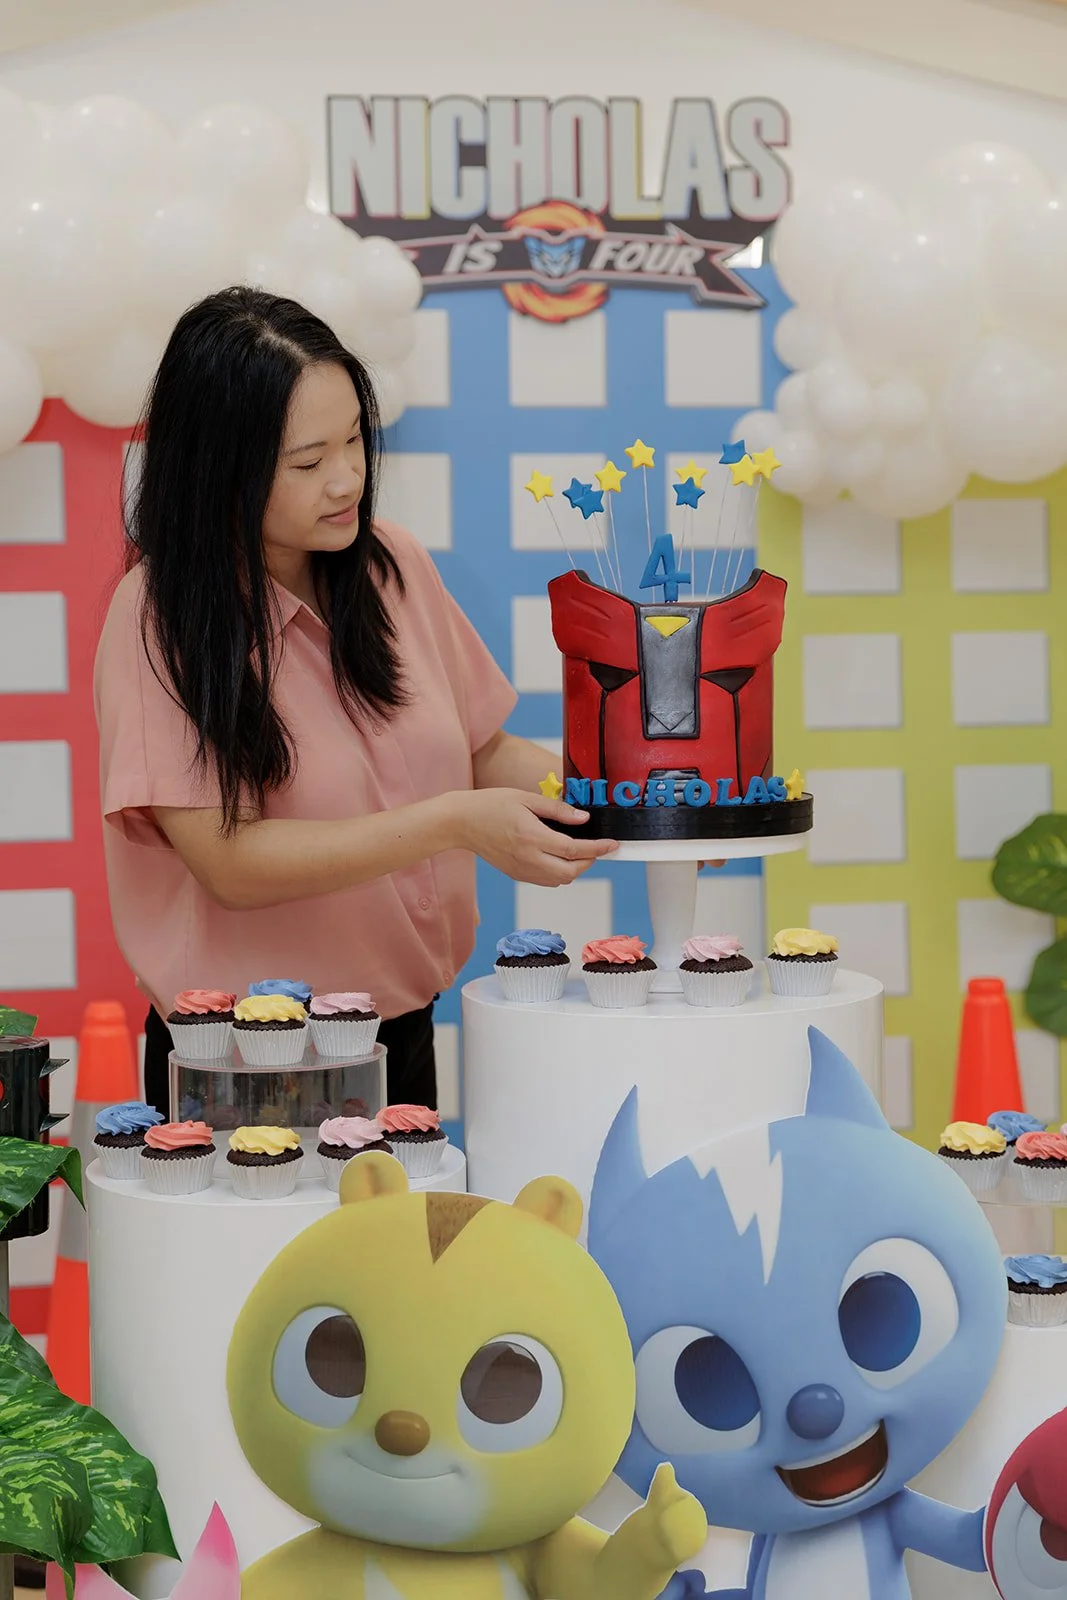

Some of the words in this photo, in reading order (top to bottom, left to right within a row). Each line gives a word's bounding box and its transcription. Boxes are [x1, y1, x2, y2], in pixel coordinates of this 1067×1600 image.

[326, 95, 793, 221] NICHOLAS
[443, 241, 503, 274] IS
[591, 240, 704, 275] FOUR
[639, 533, 691, 602] 4
[565, 776, 788, 807] NICHOLAS
